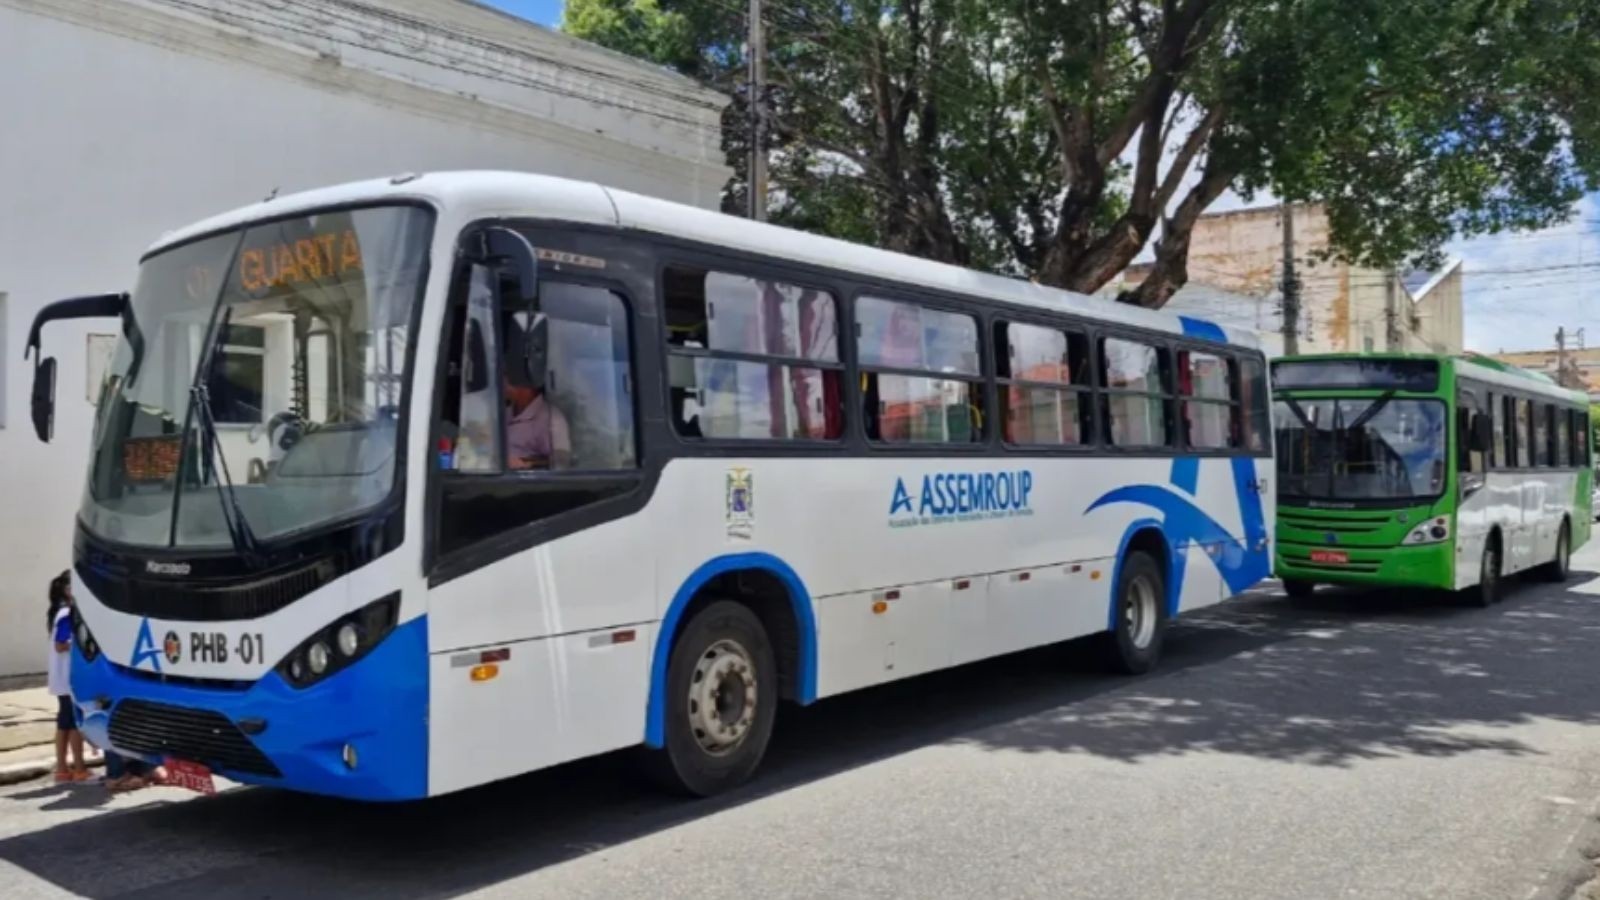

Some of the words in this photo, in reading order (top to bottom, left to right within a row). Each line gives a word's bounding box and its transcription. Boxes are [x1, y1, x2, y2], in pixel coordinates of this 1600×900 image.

[240, 229, 364, 291] GUARITA
[918, 469, 1033, 516] ASSEMROUP
[190, 631, 229, 664] PHB
